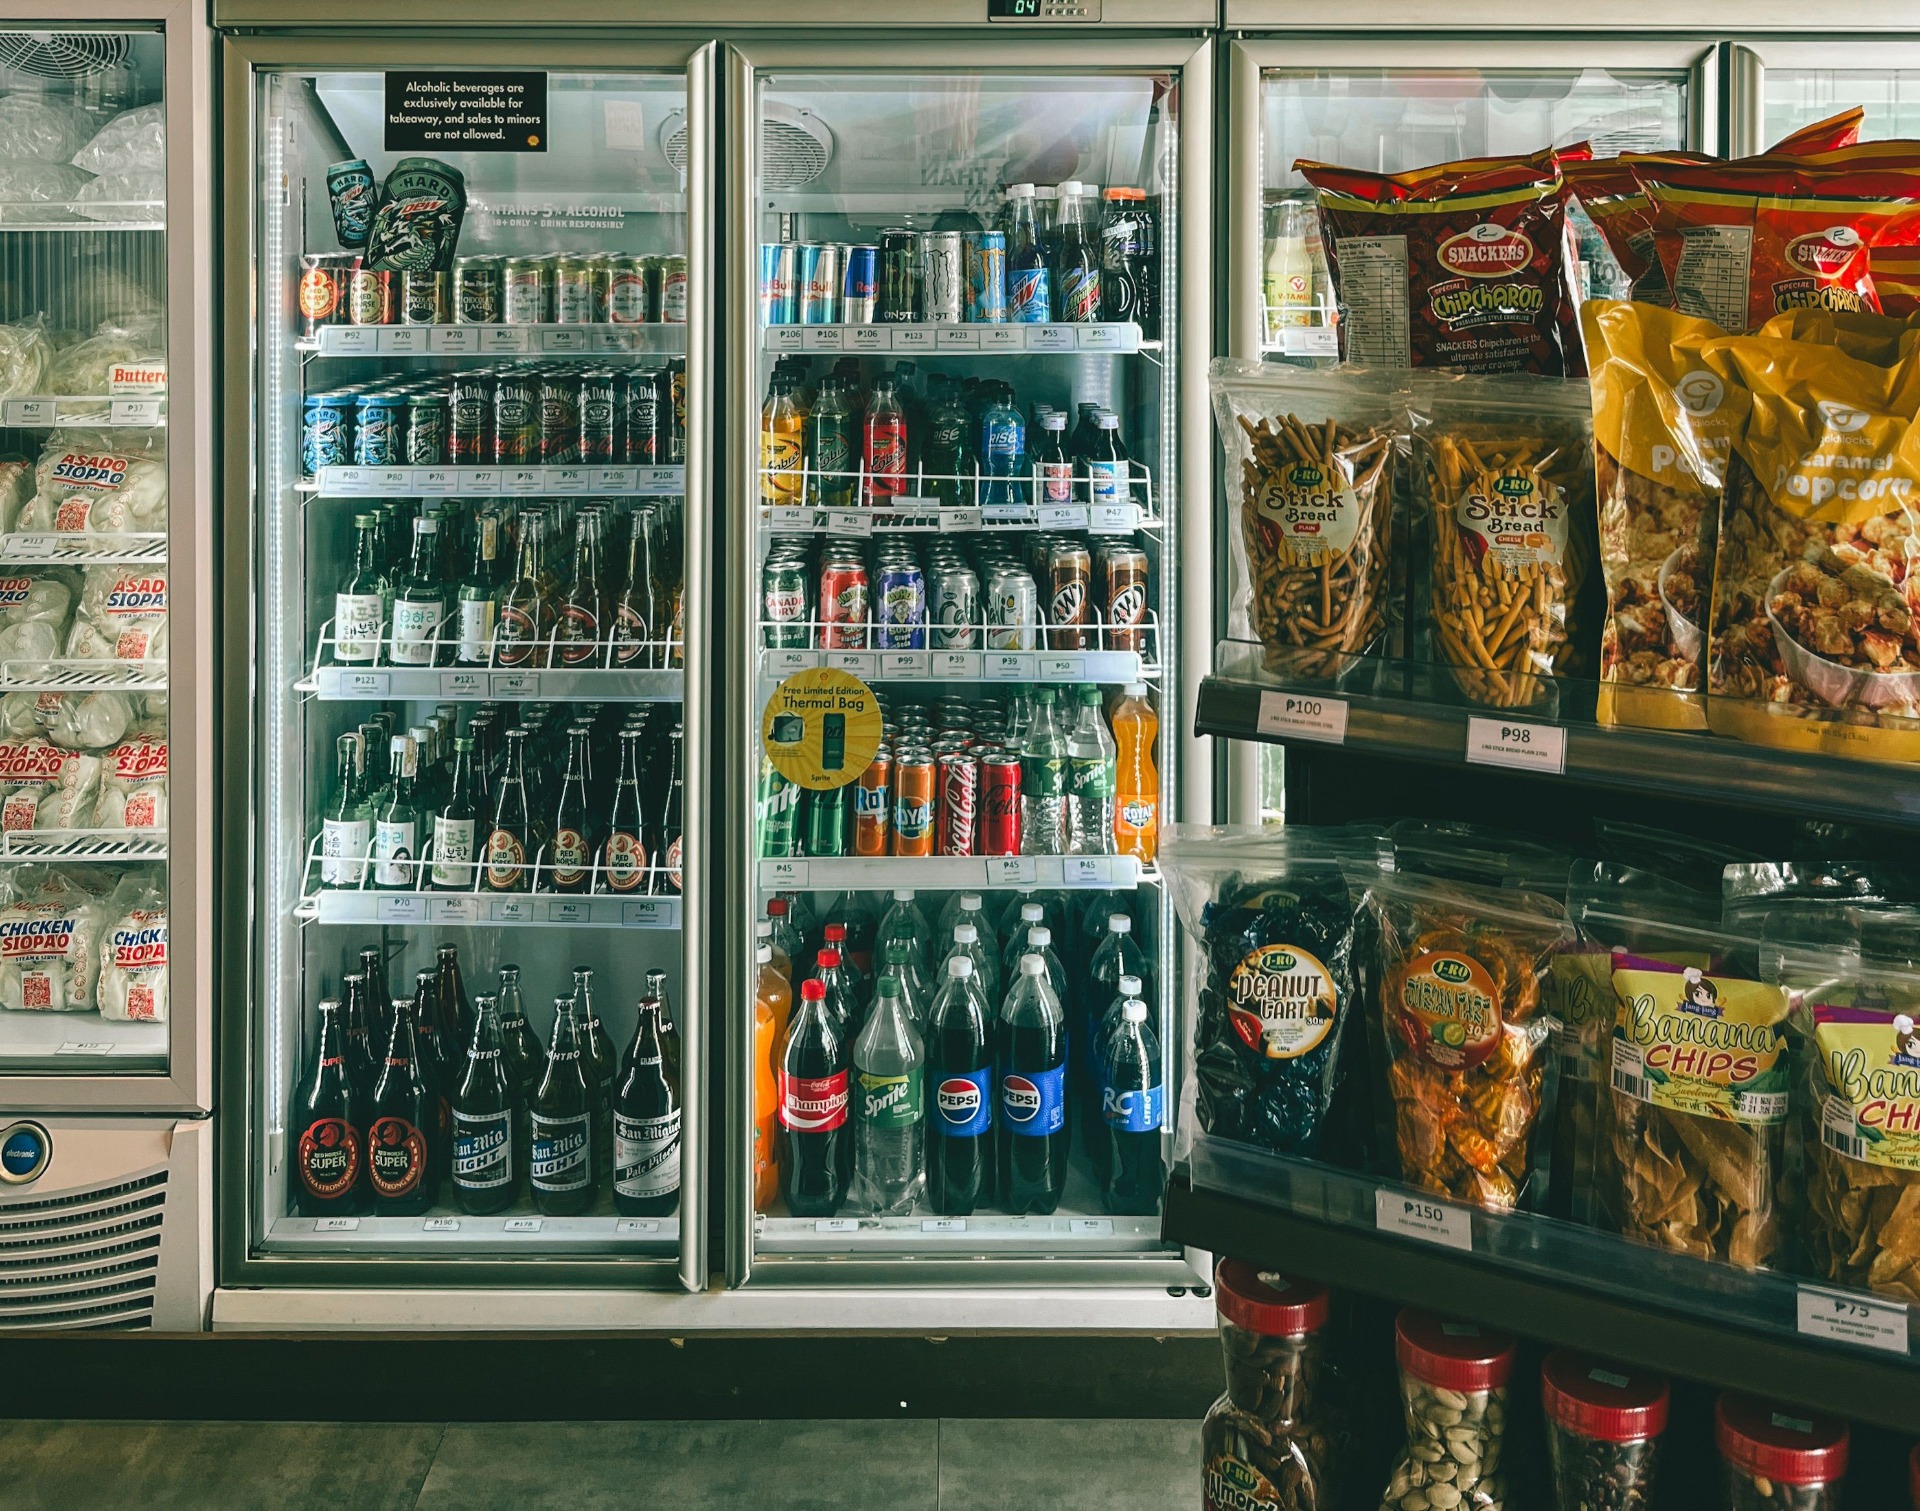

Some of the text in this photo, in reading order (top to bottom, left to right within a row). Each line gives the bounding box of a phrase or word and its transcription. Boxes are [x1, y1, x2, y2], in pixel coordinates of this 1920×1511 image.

[406, 82, 524, 94] Alcoholic beverages are
[404, 97, 523, 110] exclusively available for
[390, 113, 541, 126] takeaway, and sales to minors
[424, 129, 506, 140] are not allowed.
[337, 175, 364, 187] HARD
[404, 177, 450, 199] HARD
[566, 206, 625, 218] ALCOHOL
[510, 219, 530, 227] ONLY
[540, 219, 567, 228] DRINK
[569, 221, 625, 229] RESPONSIBLY
[1448, 245, 1525, 263] SNACKERS
[811, 281, 832, 292] Bull
[1779, 281, 1810, 293] SPECIAL
[345, 331, 361, 340] ₱92
[395, 331, 411, 339] ₱70
[447, 331, 463, 339] ₱70
[497, 331, 513, 339] ₱52
[817, 330, 838, 338] ₱106
[857, 330, 878, 338] ₱106
[1435, 340, 1478, 352] SNACKERS
[1479, 336, 1522, 350] Chipcharon
[1522, 335, 1529, 344] is
[1450, 346, 1530, 362] ultimate satisfaction
[1468, 363, 1488, 373] your
[60, 454, 128, 473] ASADO
[1800, 453, 1893, 472] Caramel
[53, 464, 124, 484] SIOPAO
[343, 471, 359, 479] ₱80
[387, 473, 403, 481] ₱80
[429, 472, 445, 480] ₱76
[475, 472, 491, 480] ₱77
[517, 472, 534, 480] ₱76
[562, 471, 578, 479] ₱76
[1292, 469, 1321, 480] J-RO
[1498, 479, 1531, 491] J-RO
[1773, 464, 1913, 505] Popcorn
[1265, 487, 1344, 510] Stick
[1465, 495, 1559, 520] Stick
[953, 513, 968, 521] ₱30
[1285, 508, 1337, 523] Bread
[1487, 518, 1545, 533] Bread
[113, 579, 166, 593] ASAD
[107, 593, 166, 607] SIOPA
[786, 654, 802, 662] ₱60
[843, 656, 859, 665] ₱99
[898, 656, 914, 665] ₱99
[1002, 657, 1018, 665] ₱39
[355, 676, 376, 684] ₱121
[784, 686, 865, 695] Free Limited Edition
[783, 697, 865, 712] Thermal Bag
[1286, 699, 1322, 716] ₱100
[1501, 726, 1531, 743] ₱98
[0, 758, 62, 773] SIOPAO
[116, 757, 167, 771] SIOPA
[811, 774, 831, 782] Sprite
[1074, 764, 1106, 790] Sprite
[892, 805, 934, 826] ROYAL
[1122, 806, 1154, 823] ROYAL
[560, 850, 574, 858] RED
[615, 854, 629, 862] RED
[556, 857, 578, 866] HORSE
[1004, 861, 1019, 869] ₱45
[1080, 861, 1096, 869] ₱45
[776, 864, 793, 873] ₱45
[395, 898, 411, 906] ₱70
[0, 919, 75, 936] CHICKEN
[2, 934, 69, 950] SIOPAO
[116, 944, 165, 961] SIOPA
[1265, 953, 1295, 966] J-RO
[1436, 960, 1469, 978] J-RO
[1237, 975, 1322, 1004] PEANUT
[1260, 1000, 1307, 1020] TART
[1624, 993, 1776, 1053] Banana
[1646, 1044, 1758, 1082] CHIPS
[1831, 1047, 1920, 1105] Ban
[1669, 1082, 1718, 1099] Sweetened
[865, 1083, 909, 1117] Sprite
[939, 1094, 978, 1106] PEPSI
[1004, 1092, 1038, 1106] PEPSI
[1102, 1086, 1134, 1116] RC
[1673, 1098, 1688, 1109] Net
[1859, 1100, 1920, 1132] CHI
[619, 1115, 681, 1140] San Miguel
[472, 1130, 504, 1156] Mig
[552, 1132, 583, 1152] Mig
[310, 1156, 347, 1169] SUPER
[375, 1156, 408, 1168] SUPER
[454, 1150, 501, 1174] LIGHT
[533, 1151, 580, 1175] LIGHT
[1890, 1155, 1906, 1166] Net
[626, 1163, 646, 1180] Pale
[316, 1180, 345, 1192] STRONG
[379, 1177, 405, 1190] STRONG
[1404, 1201, 1443, 1222] ₱150
